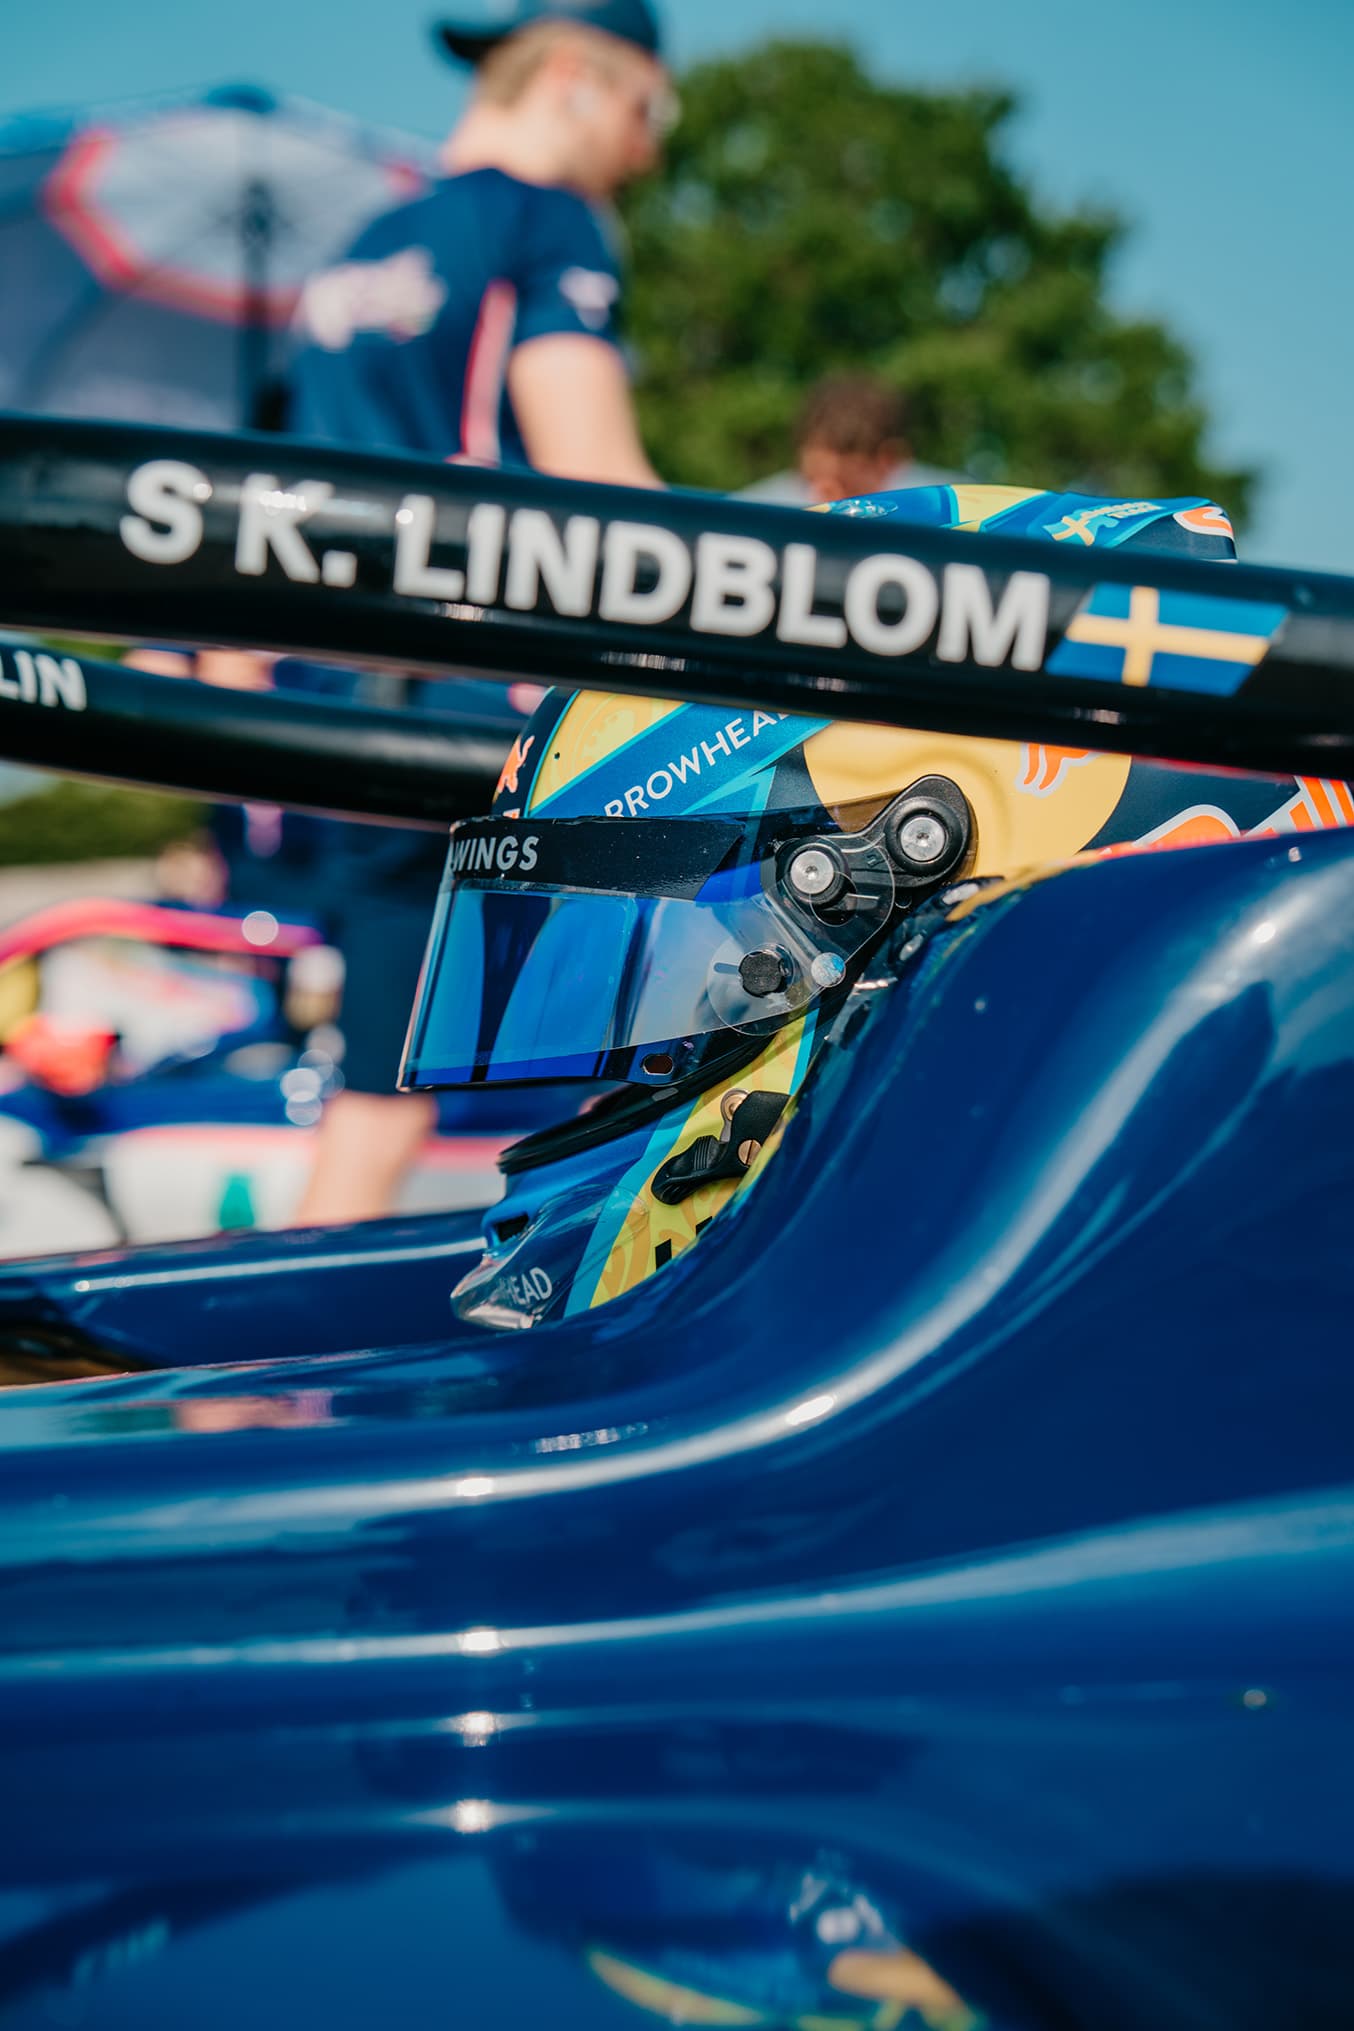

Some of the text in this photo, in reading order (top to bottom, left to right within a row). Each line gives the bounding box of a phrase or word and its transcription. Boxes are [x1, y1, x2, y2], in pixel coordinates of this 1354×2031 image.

[121, 462, 1049, 671] S K. LINDBLOM
[452, 836, 539, 871] WINGS
